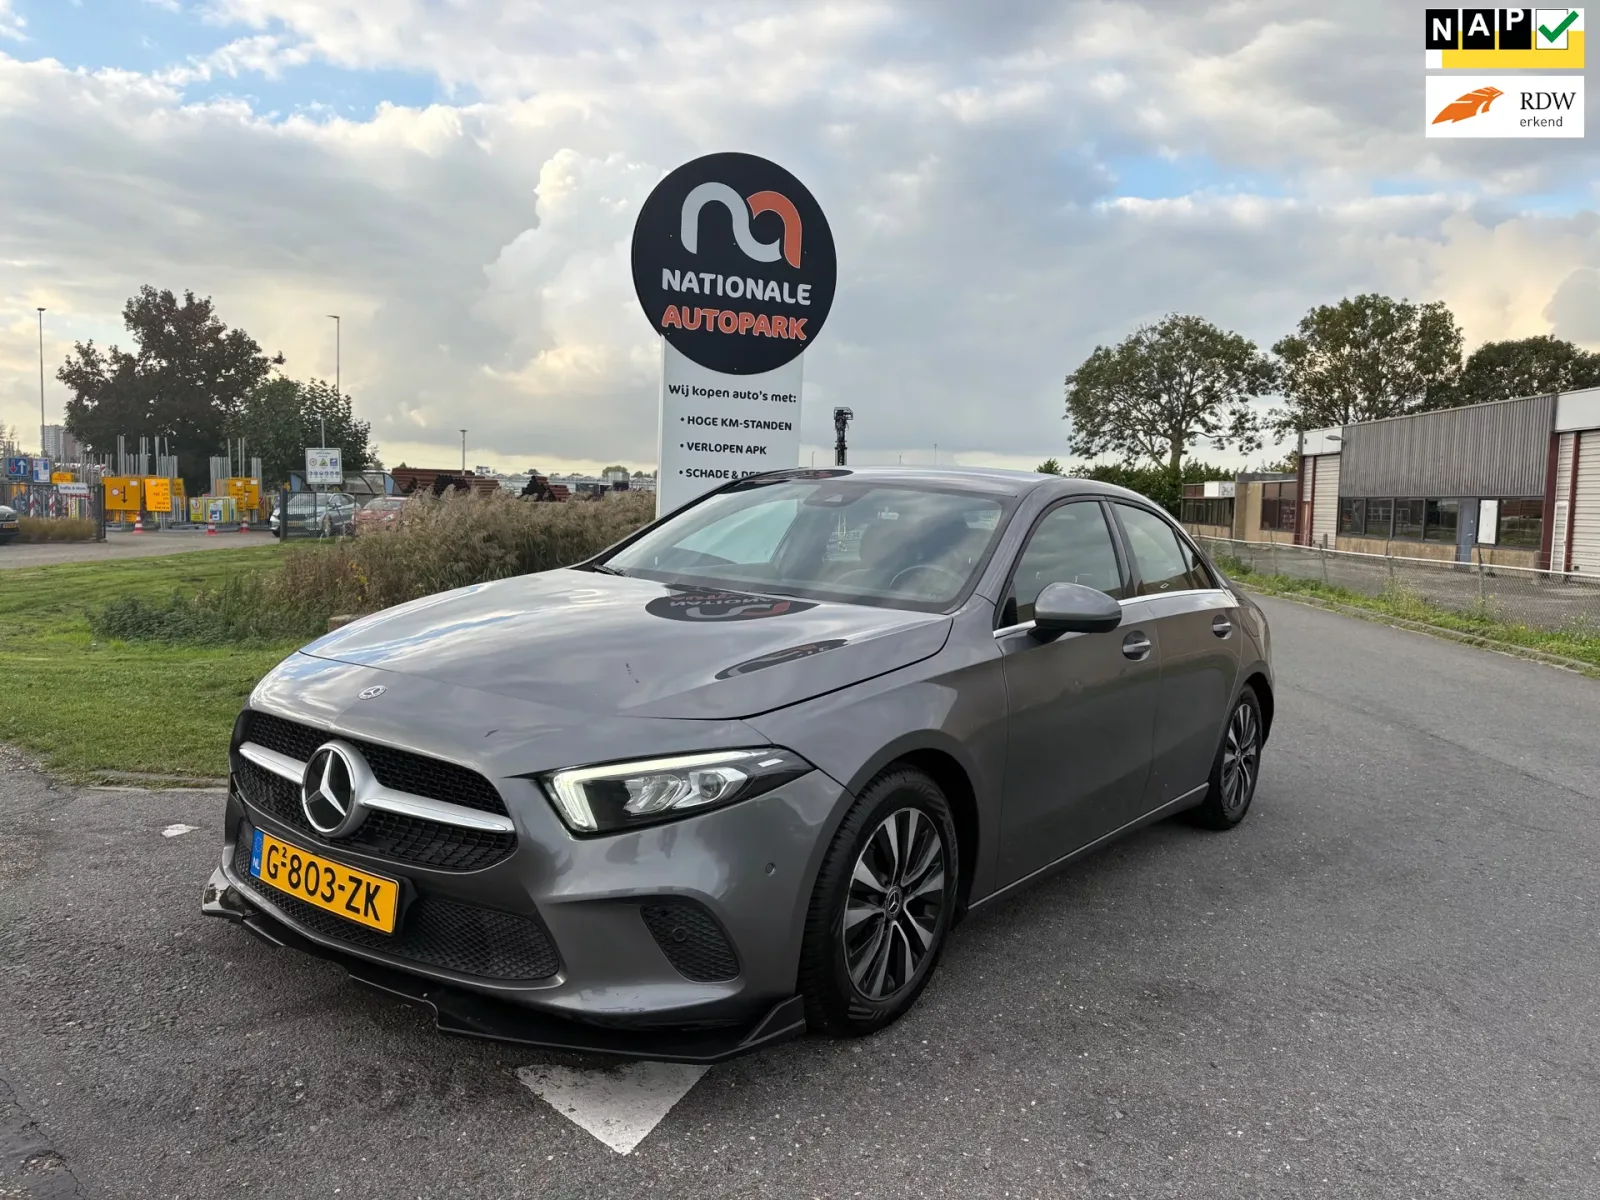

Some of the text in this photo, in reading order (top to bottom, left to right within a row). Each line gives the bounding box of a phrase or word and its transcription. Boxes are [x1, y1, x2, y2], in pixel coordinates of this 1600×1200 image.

[662, 268, 812, 305] NATIONALE
[661, 305, 808, 340] AUTOPARK
[668, 384, 797, 403] Wij kopen auto's met:
[687, 415, 792, 431] HOGE KM-STANDEN
[686, 442, 767, 455] VERLOPEN APK
[685, 468, 730, 479] SCHADE
[731, 470, 738, 479] &
[252, 858, 260, 870] NL
[266, 844, 381, 922] G-803-ZK
